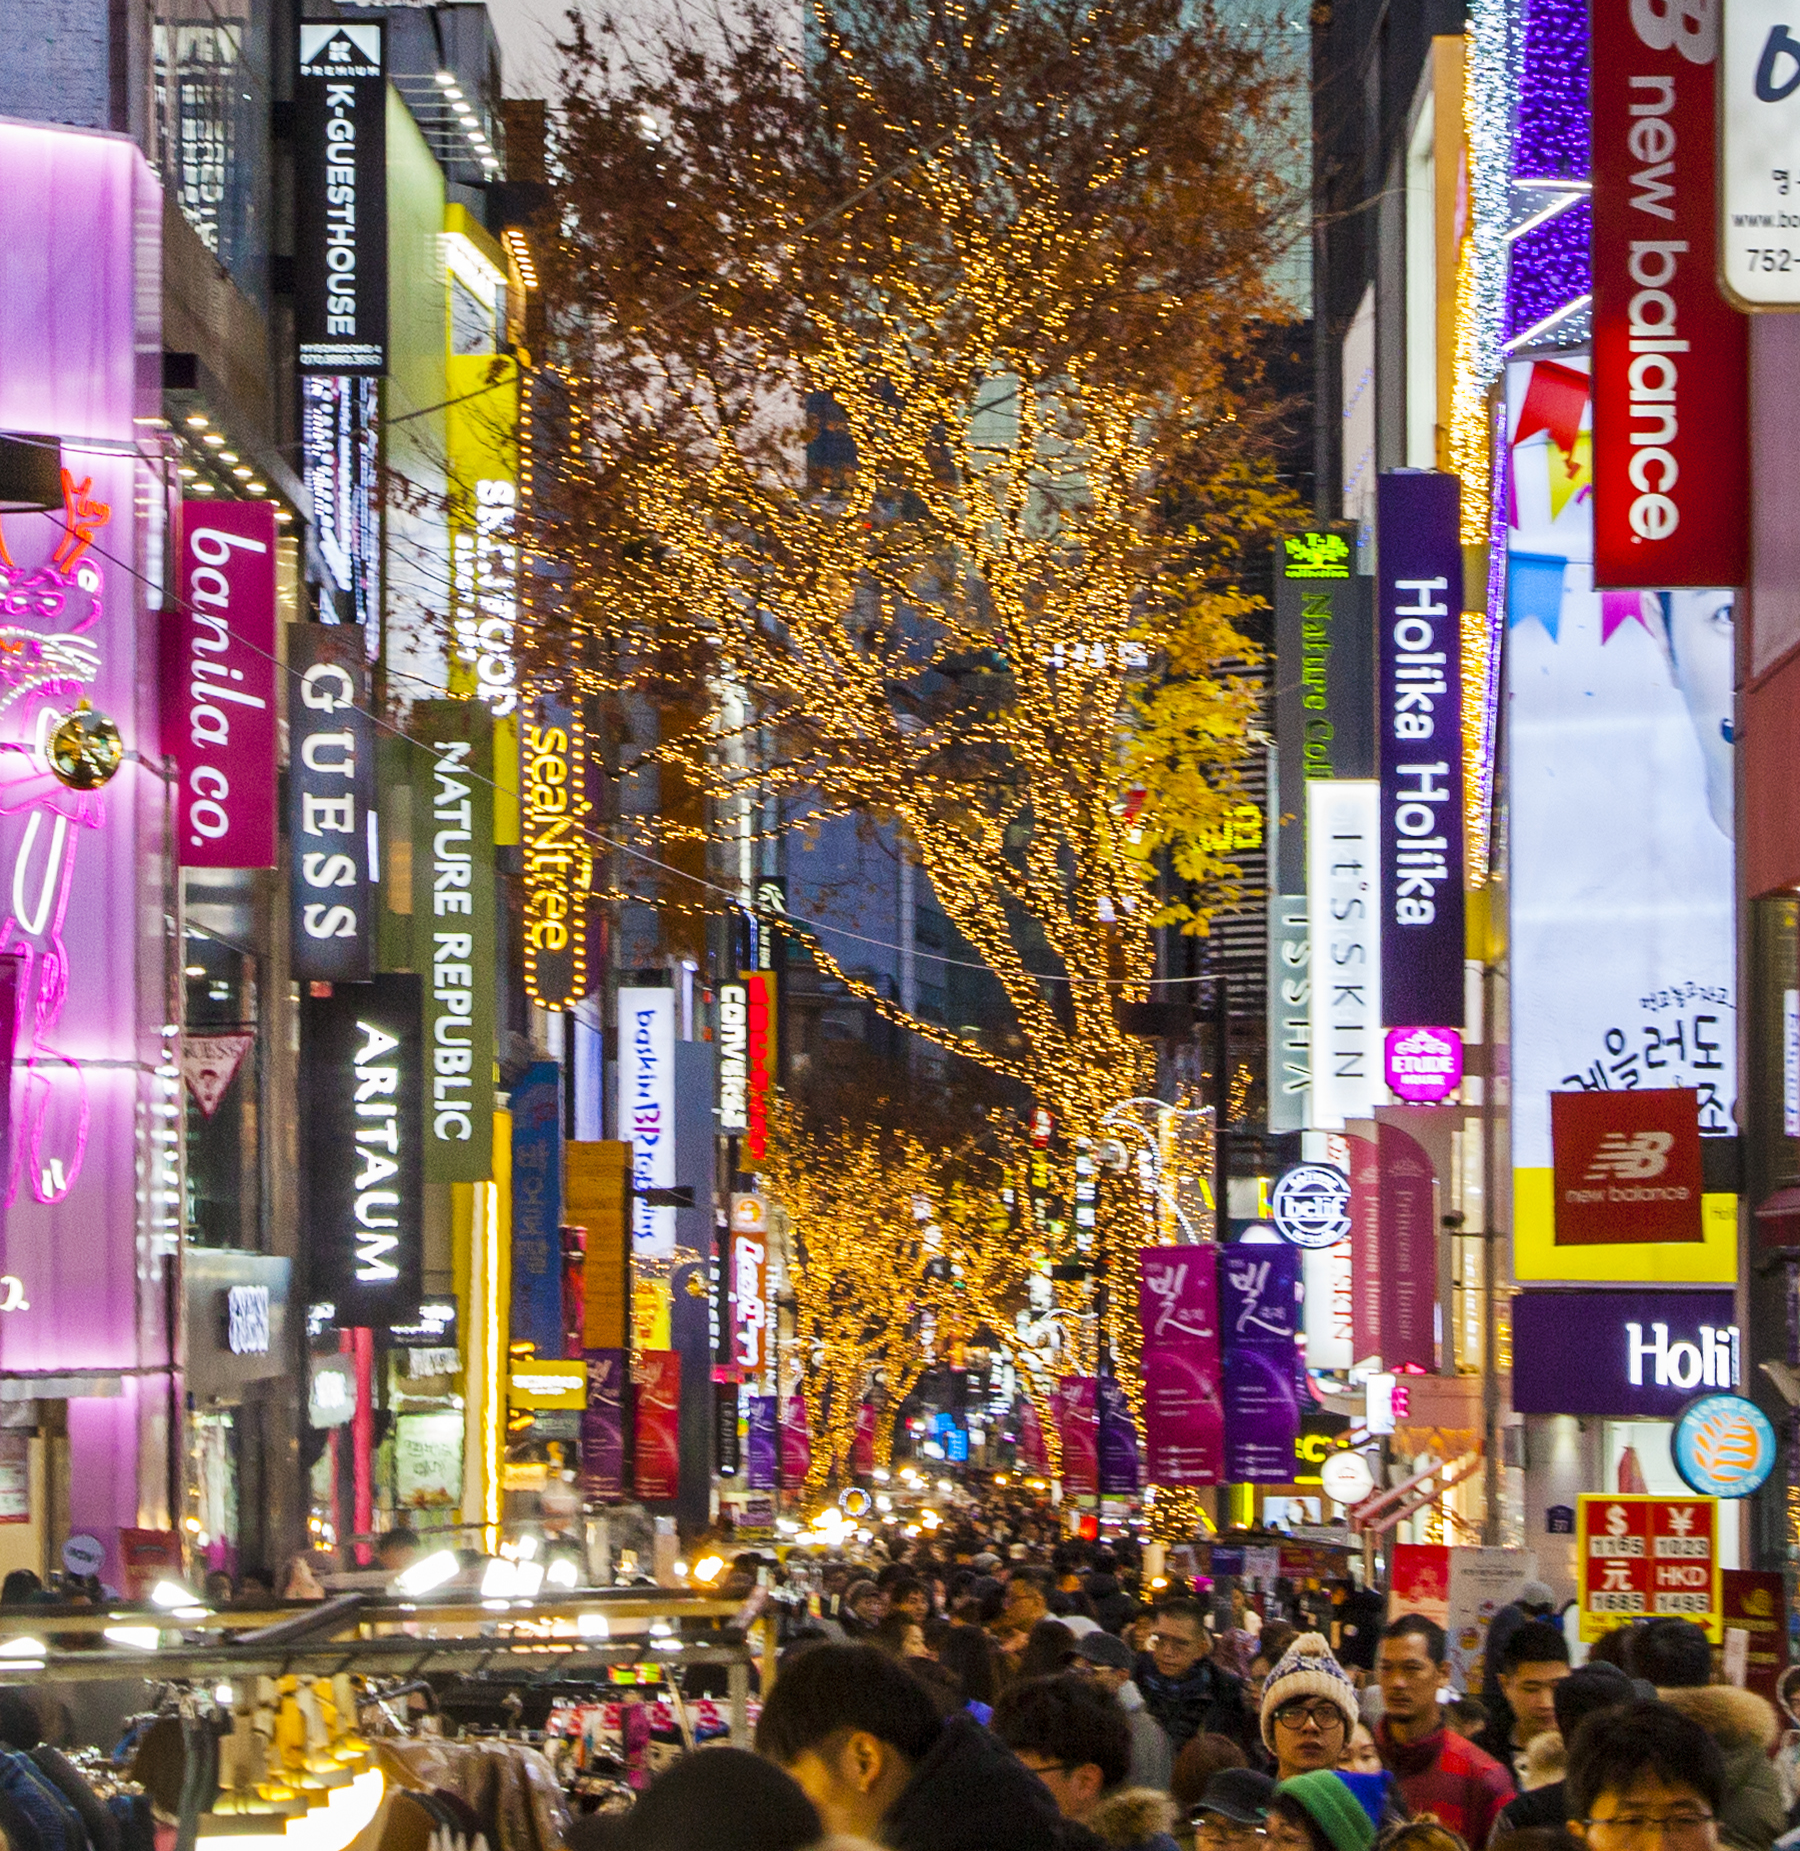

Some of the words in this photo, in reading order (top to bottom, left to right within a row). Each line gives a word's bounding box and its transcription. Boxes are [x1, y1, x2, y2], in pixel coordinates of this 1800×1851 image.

[326, 84, 357, 337] K-GUESTHOUSE
[1627, 76, 1677, 223] new
[1627, 240, 1690, 542] balance
[189, 526, 267, 750] banila
[1394, 576, 1449, 740] Holika
[189, 765, 231, 848] co.
[300, 663, 357, 940] GUESS
[434, 740, 472, 916] NATURE
[1395, 760, 1450, 926] Holika
[433, 932, 472, 1142] REPUBLIC
[1389, 1054, 1456, 1075] ETUDE
[353, 1020, 400, 1283] ARITAUM
[1601, 1559, 1634, 1591] 元
[1655, 1564, 1709, 1587] HKD
